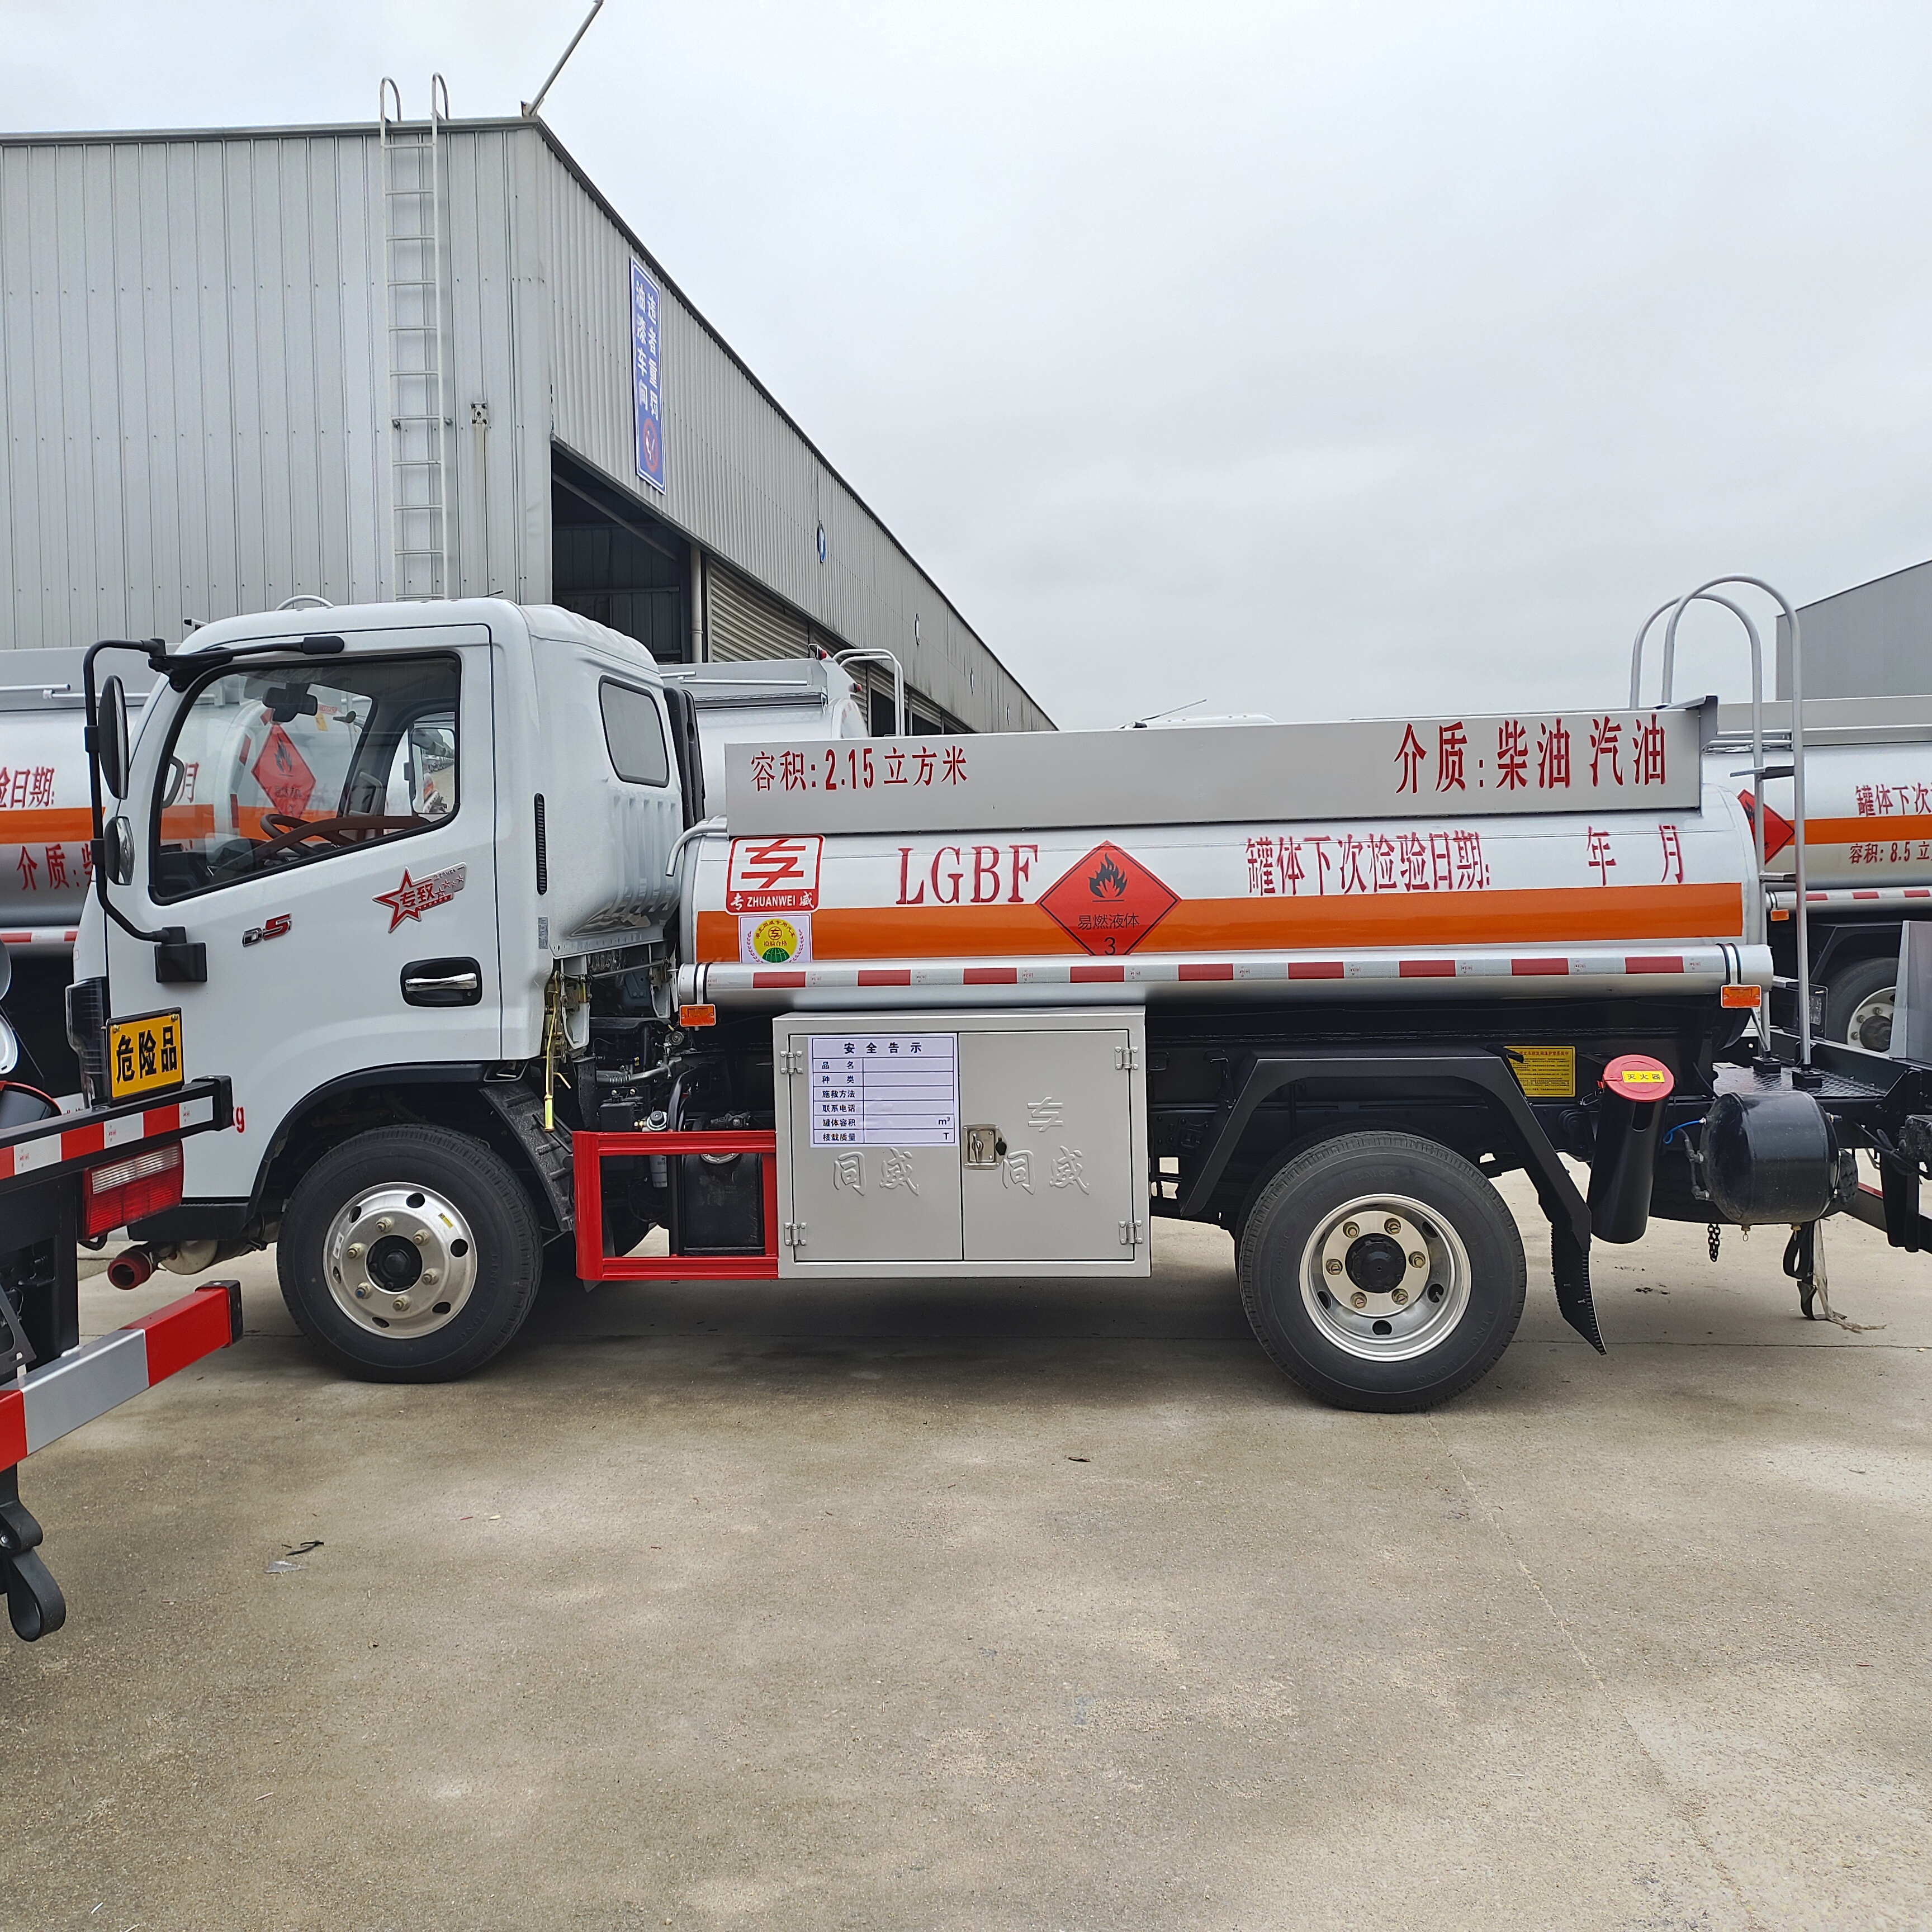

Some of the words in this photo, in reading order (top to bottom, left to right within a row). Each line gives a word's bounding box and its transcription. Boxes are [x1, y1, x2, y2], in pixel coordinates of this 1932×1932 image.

[1855, 783, 1932, 816] 罐体下次
[1586, 826, 1617, 887] 年
[1658, 823, 1685, 884] 月
[896, 845, 1039, 905] LGBF
[747, 895, 796, 908] ZHUANWEI
[1078, 912, 1140, 930] 易燃液体
[1104, 936, 1116, 956] 3
[116, 1025, 178, 1085] 危险品
[844, 1041, 922, 1055] 安全告示
[822, 1090, 856, 1098] 施救方法
[822, 1104, 856, 1113] 联系电话
[822, 1118, 856, 1128] 罐体容积
[822, 1133, 856, 1142] 核载质量
[943, 1132, 950, 1140] T
